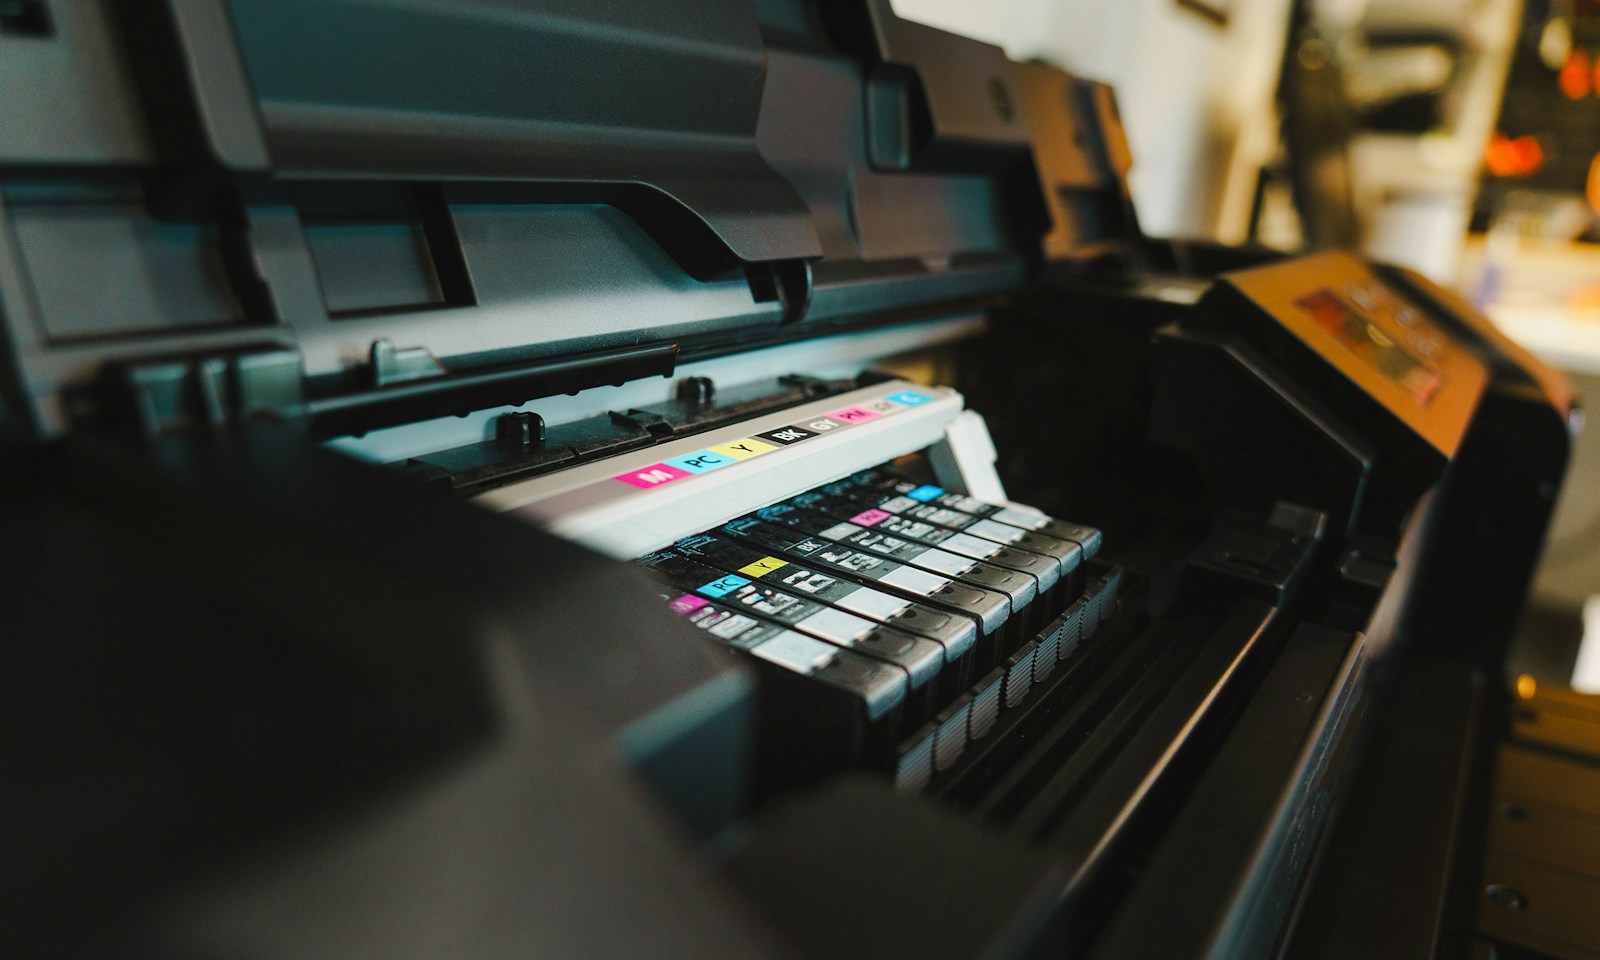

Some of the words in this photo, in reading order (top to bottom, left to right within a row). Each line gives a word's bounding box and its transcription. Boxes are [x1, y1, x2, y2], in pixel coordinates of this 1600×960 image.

[638, 469, 673, 484] M
[683, 455, 721, 468] PC
[730, 444, 753, 452] Y
[772, 428, 808, 441] BK
[809, 418, 840, 431] GY
[797, 540, 823, 553] BK
[755, 562, 771, 570] Y
[713, 579, 739, 591] PC
